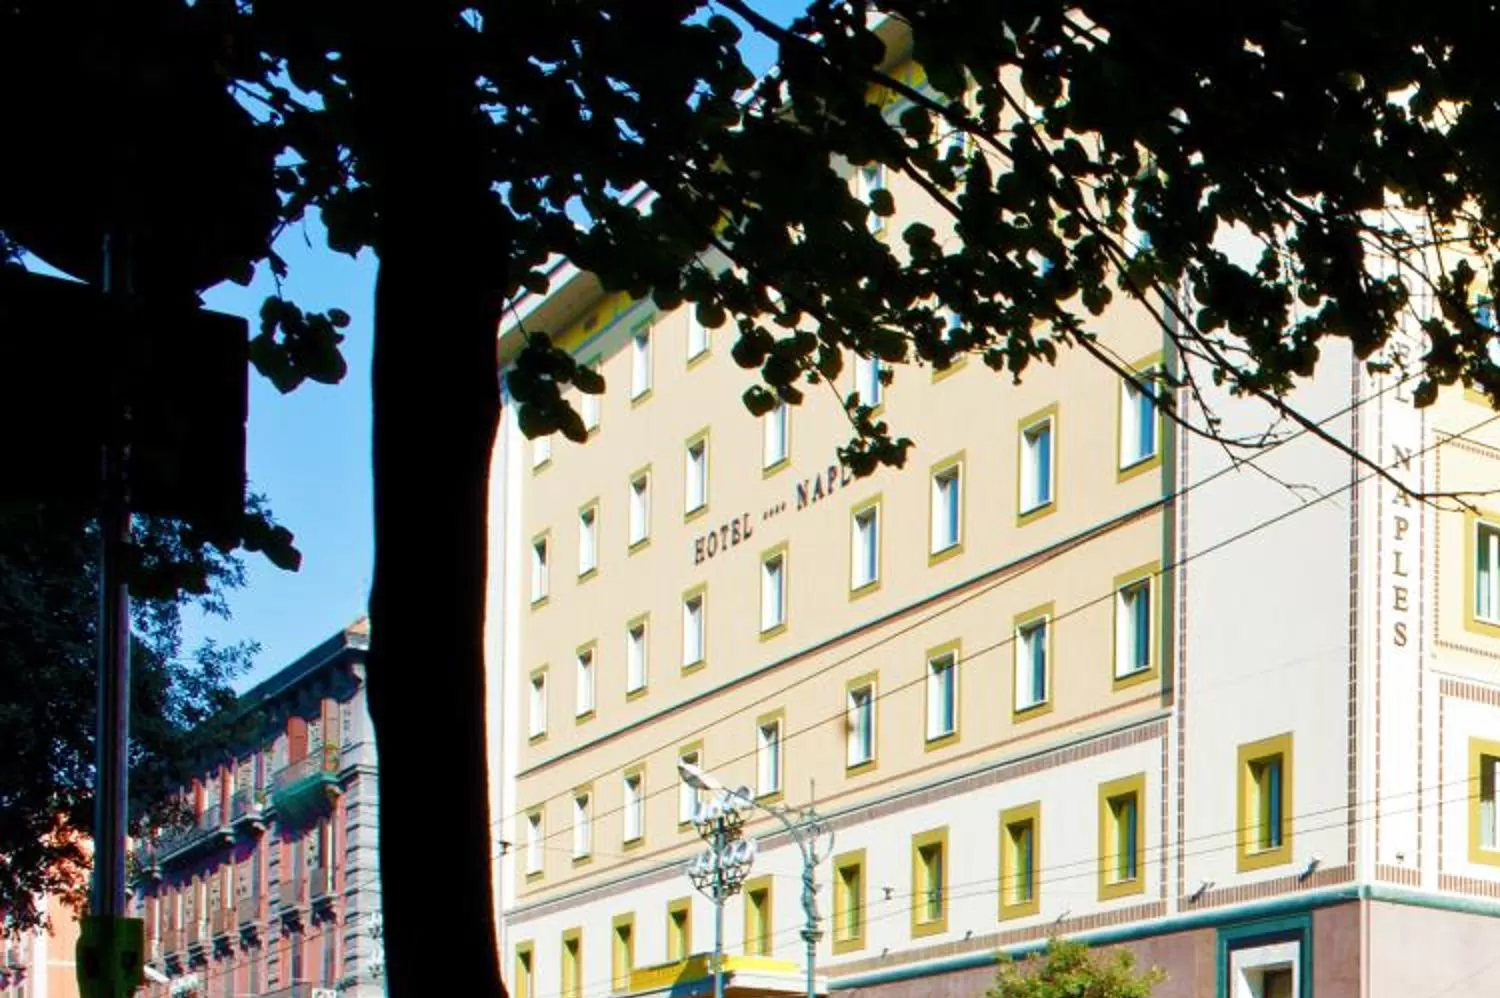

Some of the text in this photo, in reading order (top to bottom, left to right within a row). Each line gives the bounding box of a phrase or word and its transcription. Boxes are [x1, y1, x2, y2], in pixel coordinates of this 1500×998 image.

[695, 457, 860, 565] HOTEL NAPL
[1392, 443, 1412, 647] NAPLES
